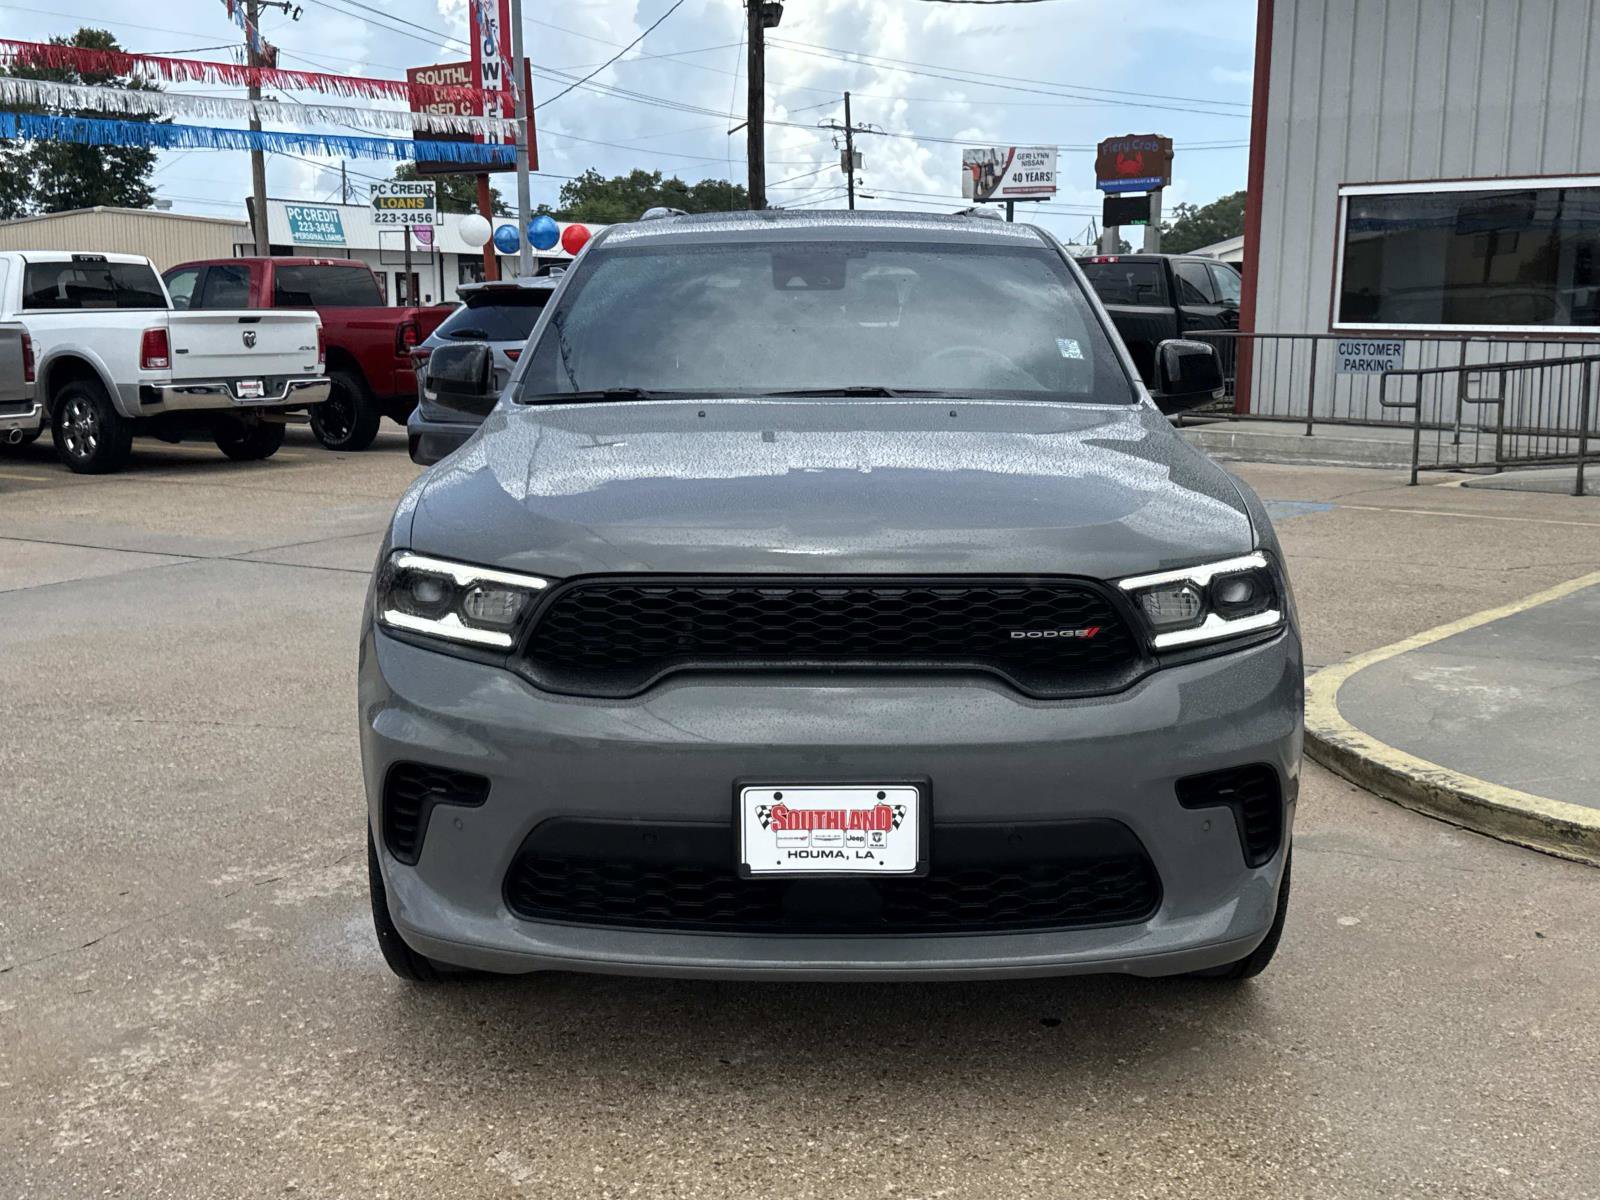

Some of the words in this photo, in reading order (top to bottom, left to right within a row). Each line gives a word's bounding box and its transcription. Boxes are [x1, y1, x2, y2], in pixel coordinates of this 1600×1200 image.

[416, 67, 473, 85] SOUTHL
[1012, 173, 1023, 183] 40
[1025, 171, 1053, 182] YEARS!
[370, 184, 387, 194] PC
[390, 184, 434, 194] CREDIT
[380, 197, 425, 209] LOANS
[287, 207, 303, 220] PC
[303, 208, 339, 223] CREDIT
[374, 213, 433, 223] 223-3456
[297, 221, 336, 233] 223-3456
[1339, 343, 1401, 356] CUSTOMER
[1344, 359, 1393, 371] PARKING
[1010, 629, 1089, 639] DODGE
[770, 804, 893, 833] SOUTHLAND
[846, 835, 865, 843] Jeep
[788, 850, 850, 860] HOUMA,
[855, 850, 875, 859] LA
